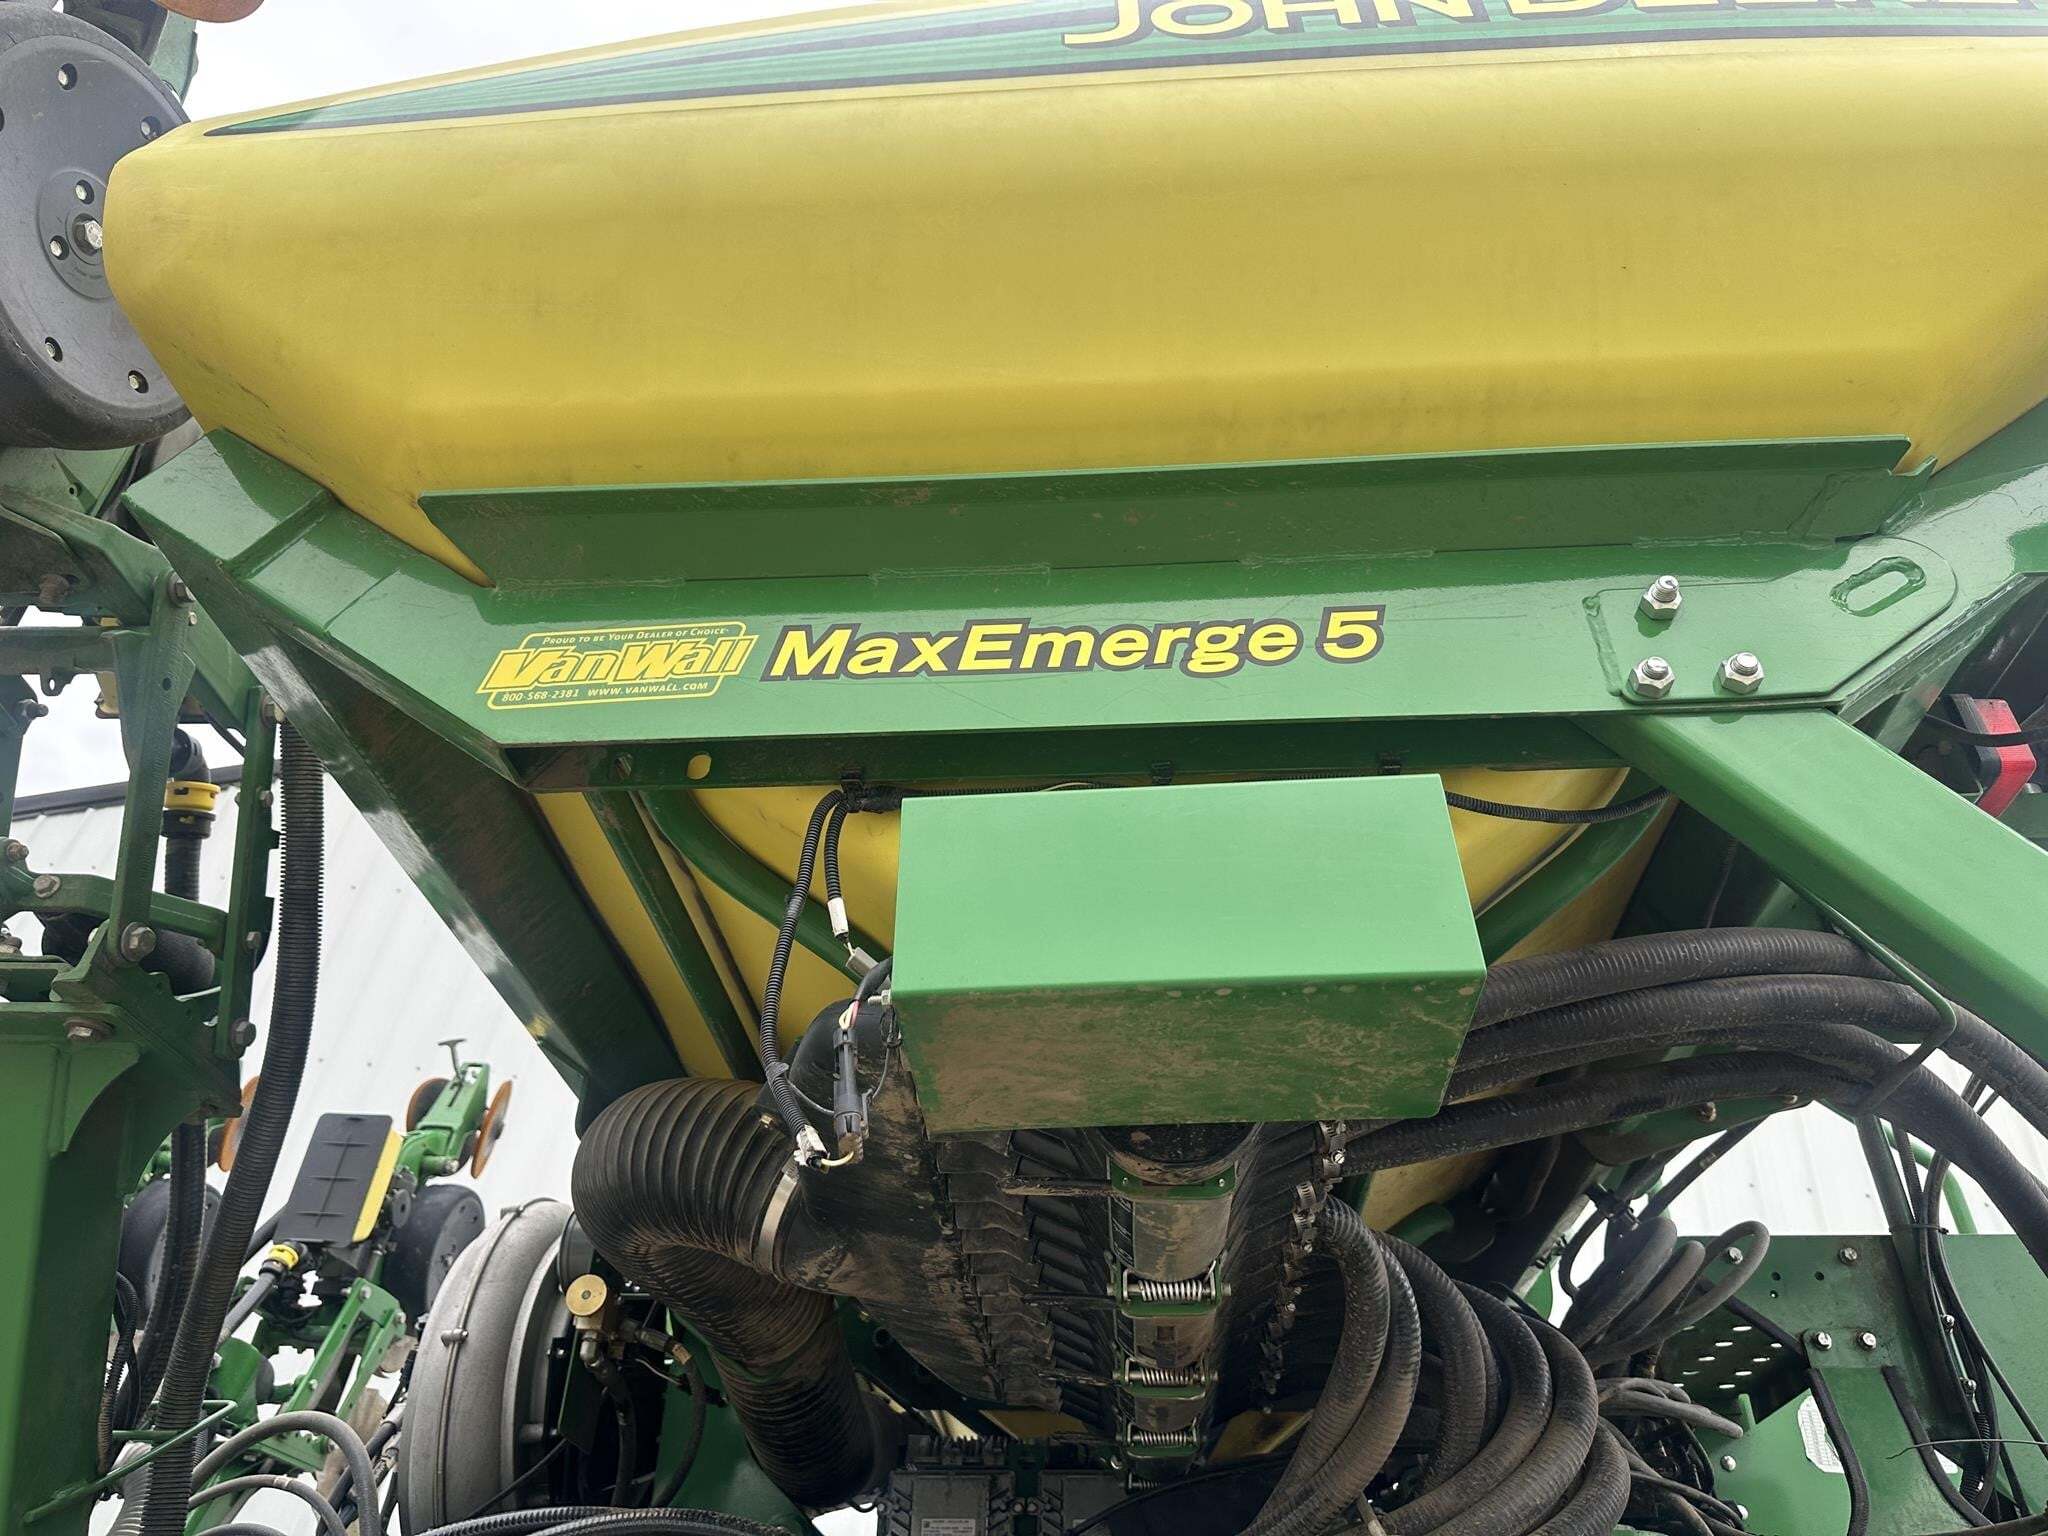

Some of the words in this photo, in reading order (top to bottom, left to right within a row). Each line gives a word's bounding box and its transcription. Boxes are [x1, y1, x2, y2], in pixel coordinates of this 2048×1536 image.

[542, 636, 576, 645] PROUD
[608, 633, 634, 641] YOUR
[636, 630, 672, 640] DEALER
[690, 627, 725, 636] CHOICE
[768, 620, 1300, 675] MaxEmerge
[1320, 608, 1381, 661] 5
[480, 637, 756, 691] VanWall
[588, 682, 708, 697] WWW.VANWALL.COM
